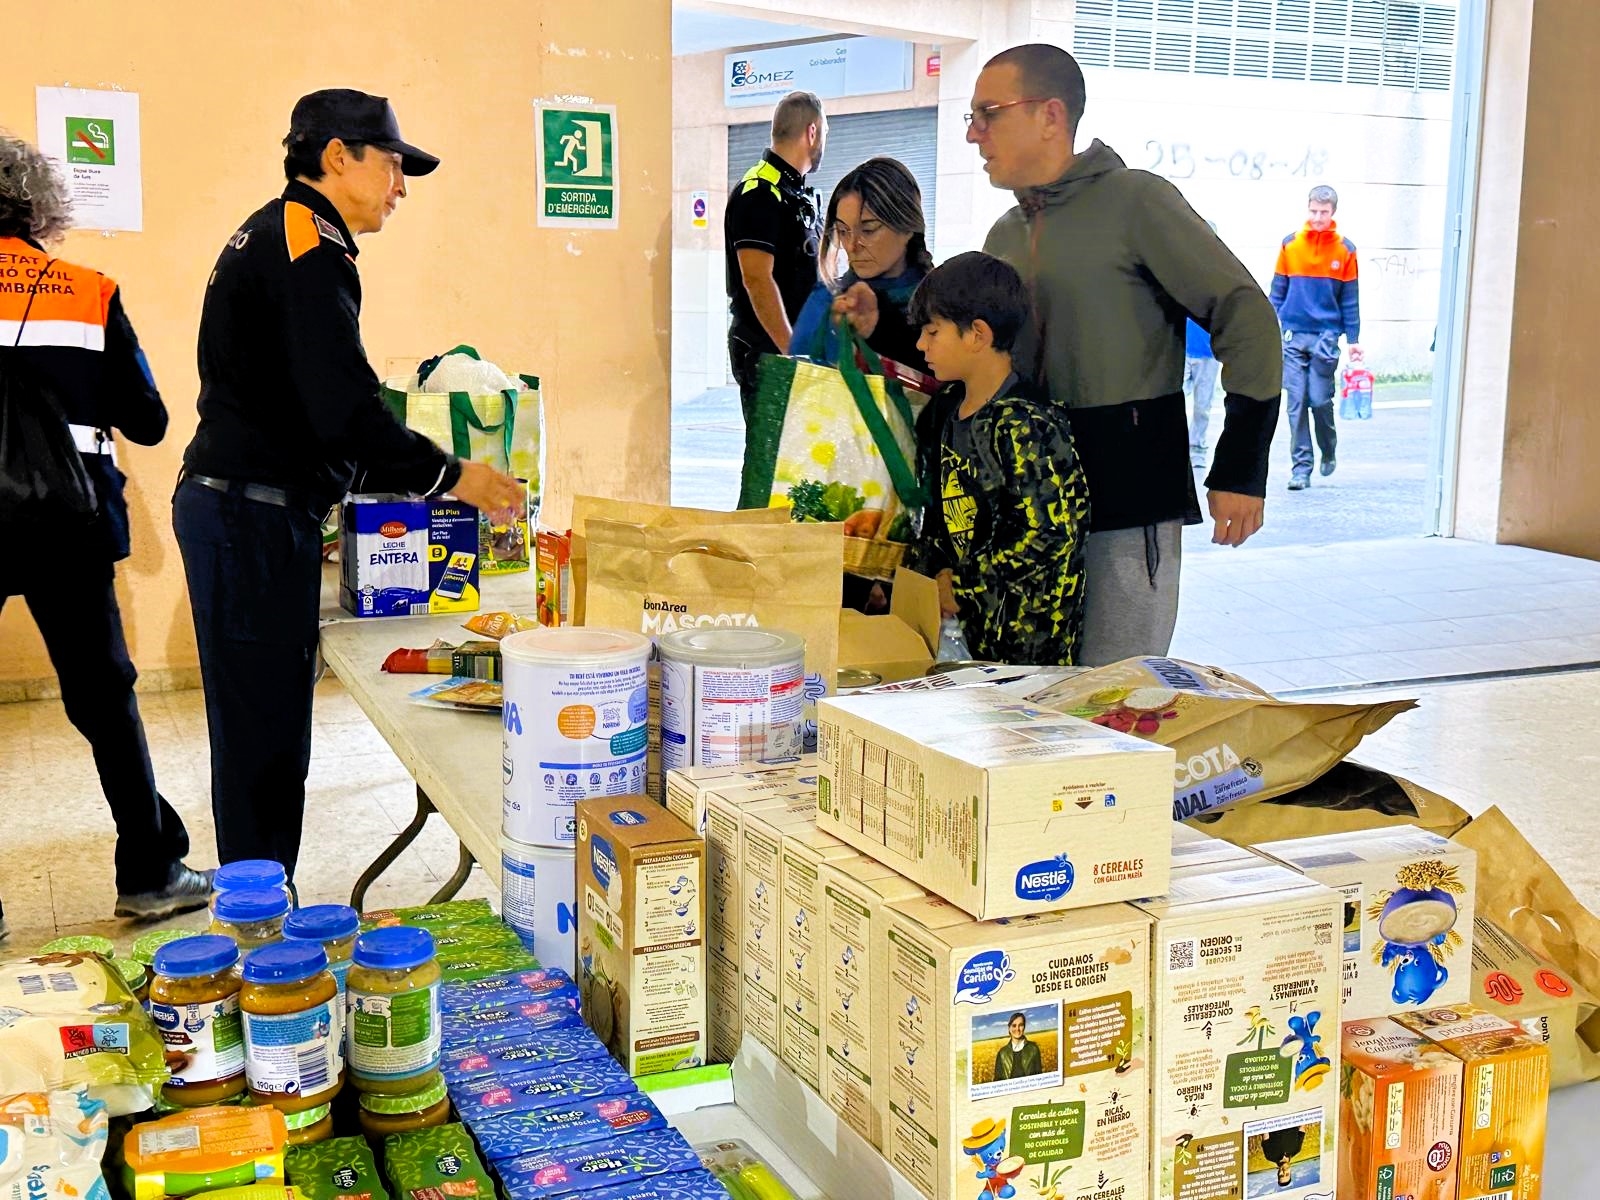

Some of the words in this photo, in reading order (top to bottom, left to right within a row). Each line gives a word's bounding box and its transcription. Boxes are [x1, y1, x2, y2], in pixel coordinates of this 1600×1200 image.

[731, 70, 794, 87] GÓMEZ
[561, 191, 597, 203] SORTIDA
[548, 202, 609, 215] D'EMERGÈNCIA
[26, 269, 73, 281] CIVIL
[370, 552, 418, 565] ENTERA
[644, 599, 687, 612] bonArea
[641, 612, 759, 635] MASCOTA
[1231, 776, 1248, 788] fresca
[1093, 864, 1098, 875] 8
[1101, 858, 1144, 875] CEREALES
[1022, 870, 1067, 889] Nestlé
[1106, 874, 1126, 883] GALLETA
[1127, 871, 1142, 879] MARÍA
[1200, 935, 1232, 947] ORIGEN
[1200, 945, 1232, 957] SECRETO
[1233, 944, 1242, 953] EL
[1049, 954, 1093, 969] CUIDAMOS
[1205, 955, 1236, 965] DESCUBRE
[964, 971, 993, 984] Cariño
[1032, 972, 1048, 983] LOS
[1049, 962, 1109, 981] INGREDIENTES
[1035, 981, 1062, 994] DESDE
[1064, 979, 1073, 989] EL
[1075, 973, 1106, 988] ORIGEN
[1273, 979, 1309, 992] MINERALES
[1275, 987, 1313, 998] VITAMINAS
[1187, 1000, 1230, 1013] INTEGRALES
[1217, 1007, 1233, 1016] CON
[1183, 1010, 1216, 1022] CEREALES
[501, 1051, 538, 1060] Hero
[1244, 1056, 1268, 1064] CALIDAD
[1240, 1064, 1270, 1073] CONTROLES
[1250, 1074, 1264, 1082] más
[257, 1081, 273, 1091] 190g
[525, 1084, 563, 1095] Hero
[1177, 1084, 1201, 1095] HIERRO
[1202, 1083, 1212, 1091] EN
[1253, 1081, 1283, 1090] SOSTENIBLE
[1184, 1092, 1205, 1102] RICAS
[1229, 1093, 1249, 1102] cultivo
[1258, 1090, 1284, 1099] Cereales
[545, 1111, 584, 1121] Hero
[1019, 1111, 1046, 1121] Cereales
[1048, 1109, 1056, 1118] de
[1058, 1108, 1079, 1116] cultivo
[1104, 1105, 1124, 1117] RICAS
[1019, 1121, 1054, 1130] SOSTENIBLE
[1060, 1118, 1078, 1126] LOCAL
[1097, 1119, 1106, 1127] EN
[1108, 1111, 1131, 1125] HIERRO
[542, 1123, 570, 1133] Buenas
[572, 1119, 601, 1127] Noches
[1042, 1129, 1055, 1137] más
[1057, 1128, 1065, 1136] de
[1035, 1138, 1069, 1148] CONTROLES
[564, 1155, 594, 1163] Noches
[596, 1148, 626, 1158] Buenas
[1038, 1149, 1064, 1158] CALIDAD
[443, 1156, 459, 1174] Hero
[581, 1160, 623, 1172] Hero
[340, 1169, 355, 1187] Hero
[1094, 1185, 1125, 1199] CEREALES
